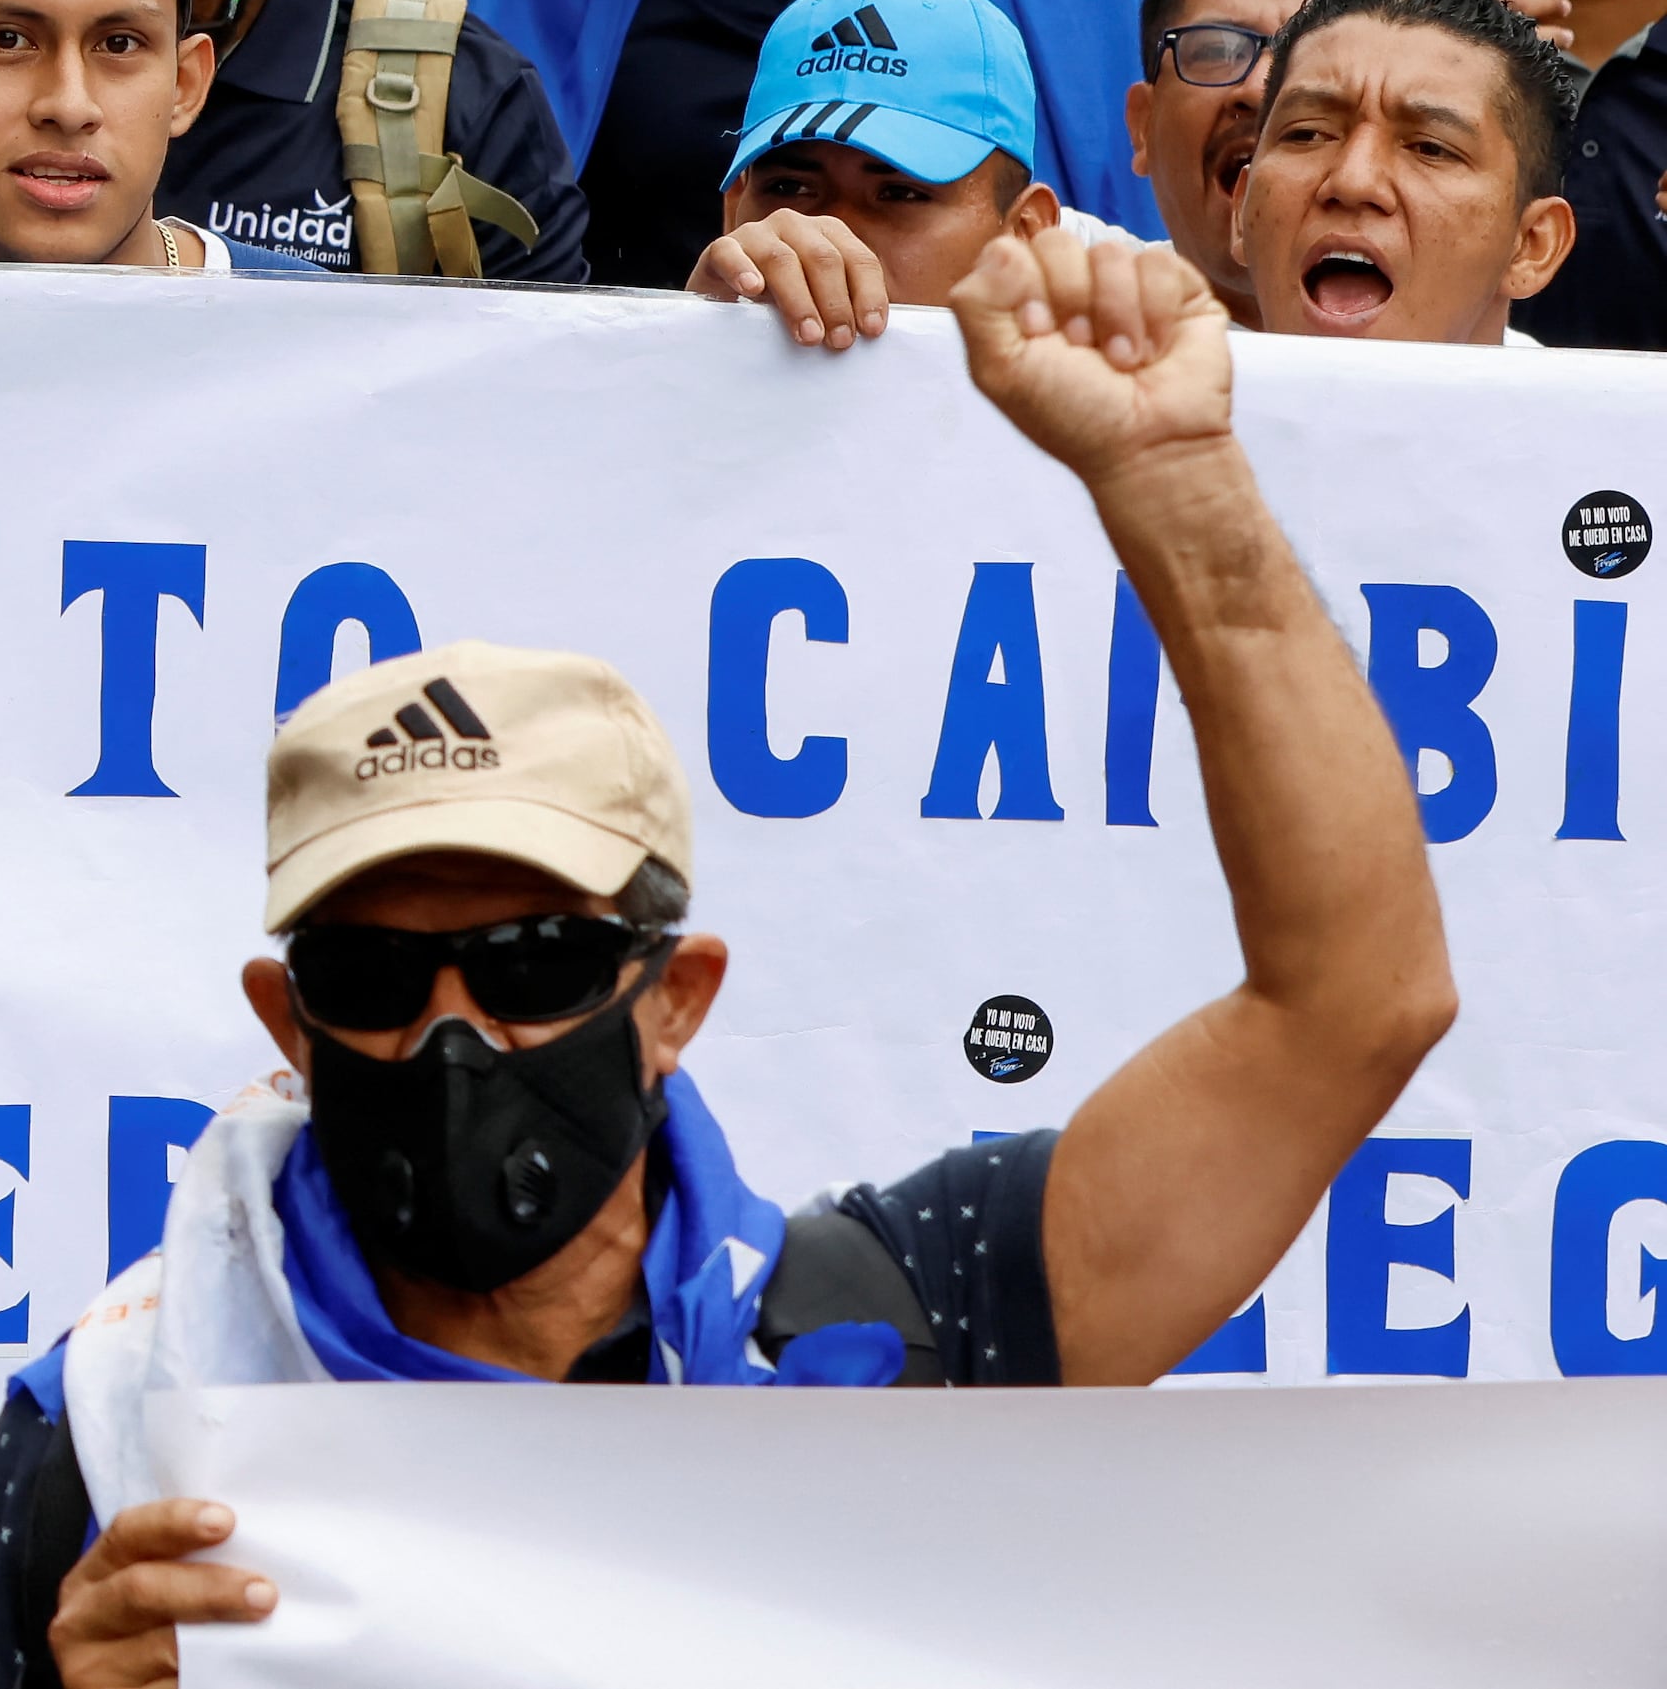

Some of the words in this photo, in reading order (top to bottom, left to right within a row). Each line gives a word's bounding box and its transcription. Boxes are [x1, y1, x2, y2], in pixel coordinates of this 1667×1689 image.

[796, 48, 909, 77] adidas
[208, 201, 354, 250] Unidad
[1579, 508, 1592, 526] YO
[1593, 506, 1606, 525] NO
[1607, 506, 1631, 524] VOTO
[1568, 529, 1582, 547] ME
[1583, 527, 1610, 547] QUEDO
[1611, 526, 1623, 544] EN
[1624, 524, 1648, 543] CASA
[355, 737, 501, 781] adidas
[986, 1008, 998, 1026] YO
[998, 1010, 1011, 1028] NO
[1013, 1012, 1036, 1031] VOTO
[970, 1027, 984, 1045] ME
[984, 1029, 1011, 1049] QUEDO
[1012, 1032, 1024, 1050] EN
[1025, 1034, 1047, 1054] CASA
